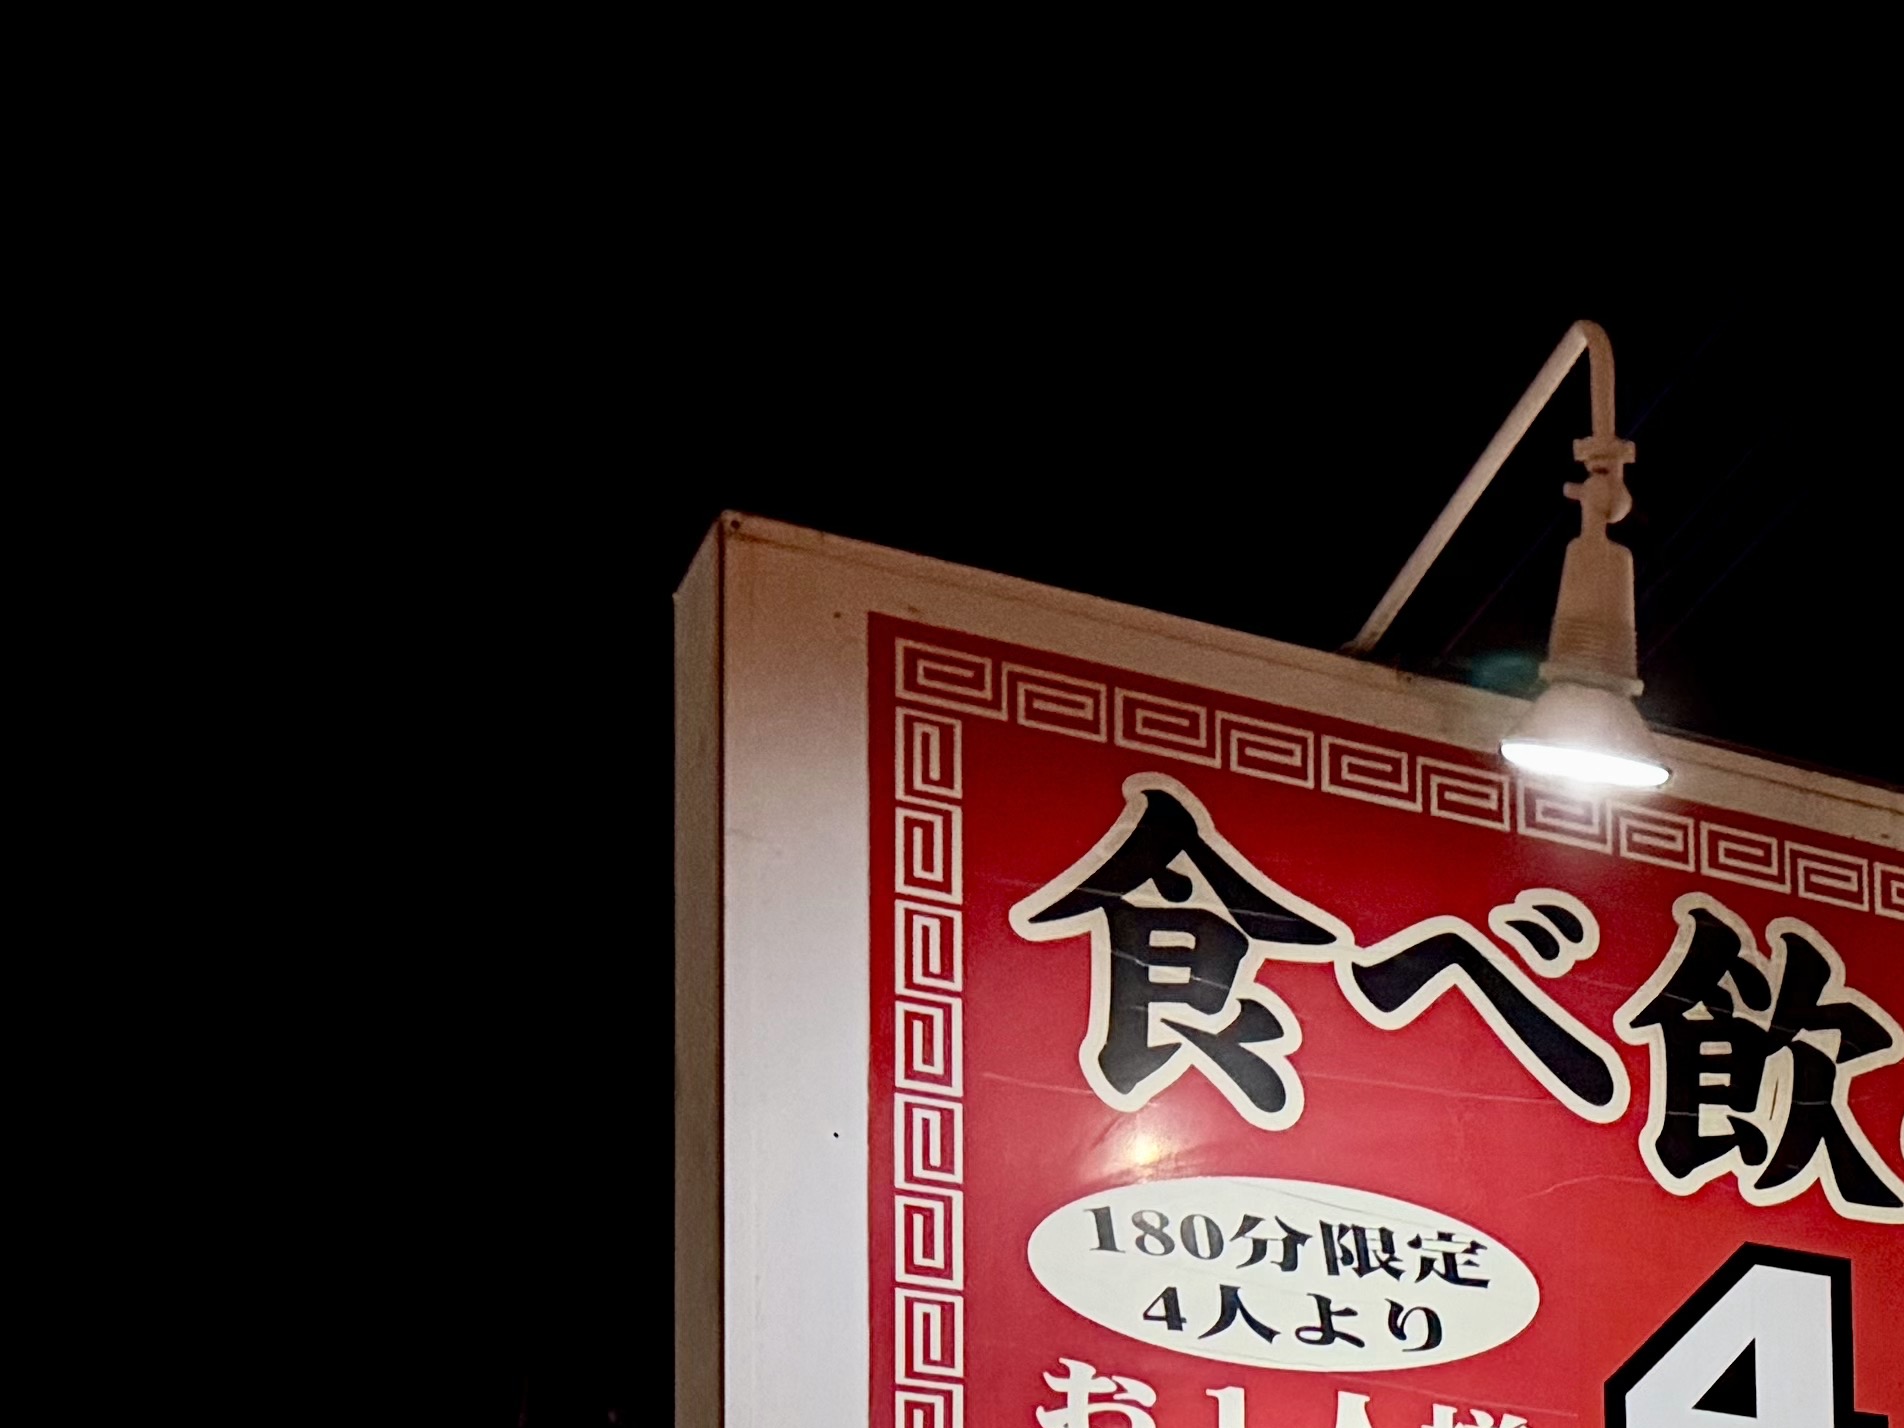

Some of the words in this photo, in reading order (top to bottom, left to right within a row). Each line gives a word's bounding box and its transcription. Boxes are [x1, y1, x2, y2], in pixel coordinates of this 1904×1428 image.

[1084, 1205, 1491, 1289] 180分限定
[1142, 1283, 1444, 1353] 4人より
